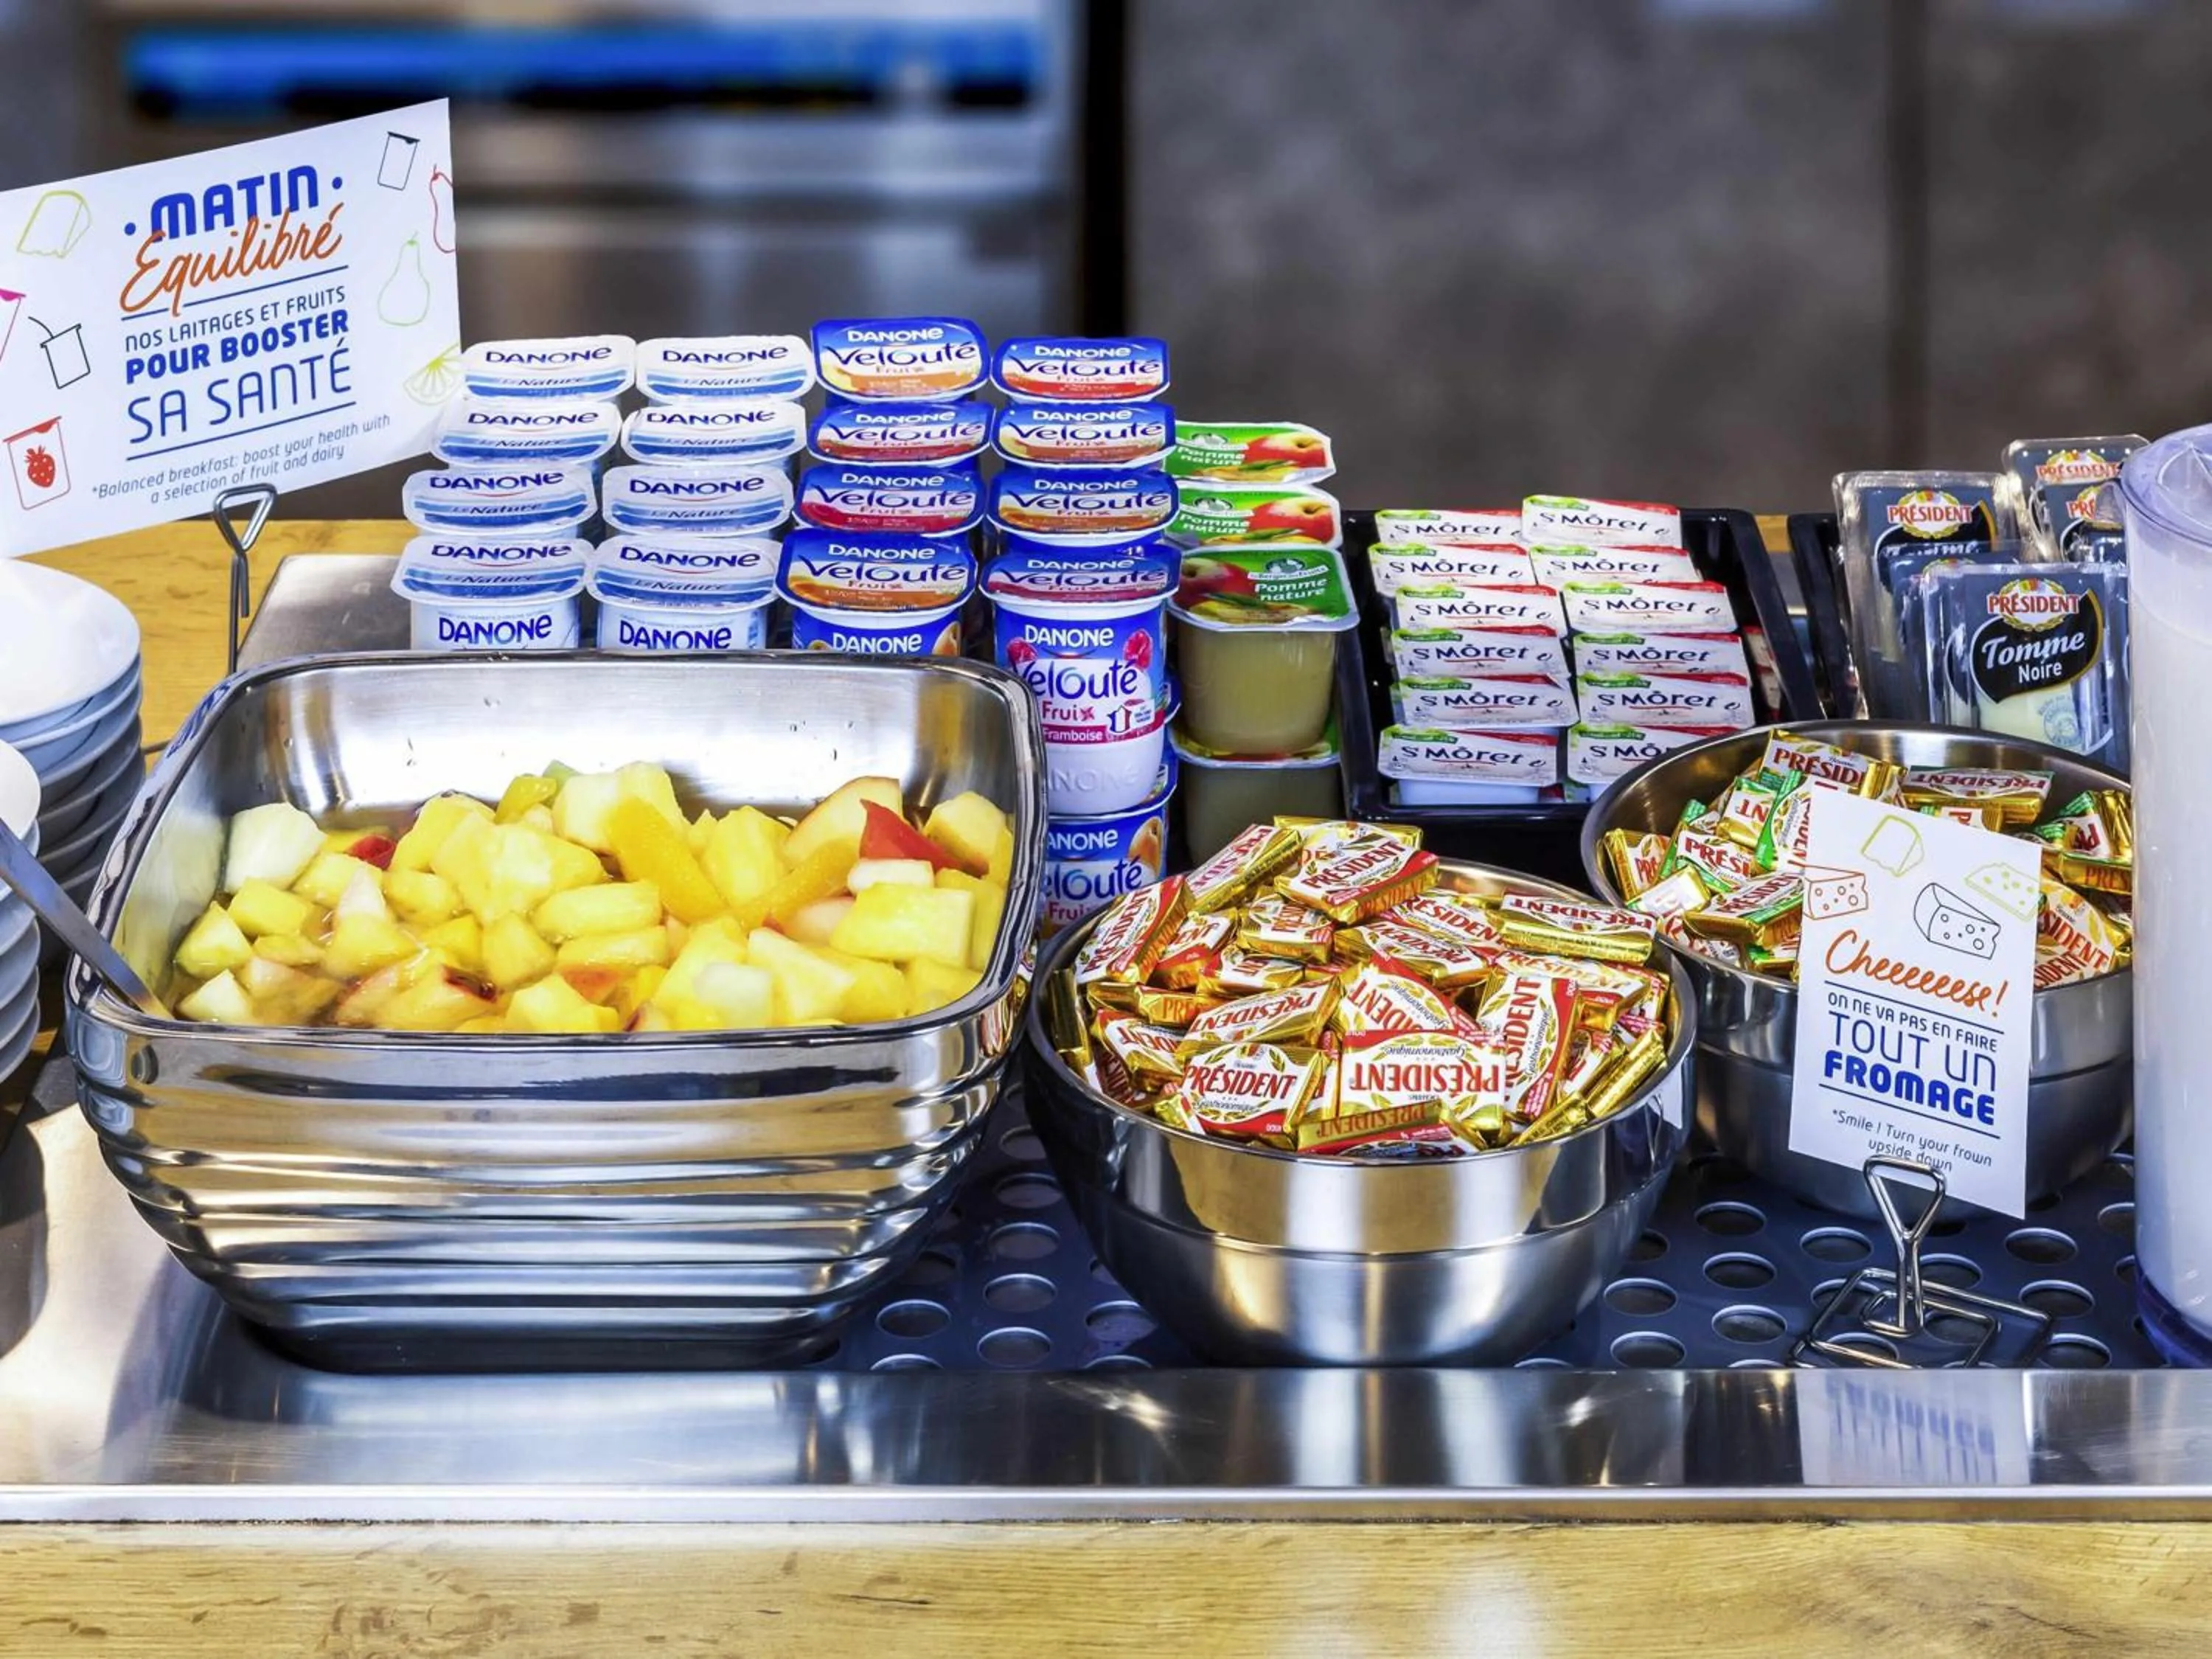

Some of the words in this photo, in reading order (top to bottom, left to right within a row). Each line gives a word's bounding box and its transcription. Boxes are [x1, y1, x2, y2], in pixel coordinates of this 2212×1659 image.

[150, 165, 319, 243] MATIN
[119, 202, 344, 317] Equilibré
[125, 330, 163, 352] NOS
[170, 308, 254, 342] LAITAGES
[260, 302, 280, 321] ET
[287, 286, 346, 315] FRUITS
[848, 327, 944, 343] DANONE
[126, 344, 210, 384] POUR
[221, 310, 349, 363] BOOSTER
[485, 347, 612, 364] DANONE
[663, 347, 789, 364] DANONE
[1034, 345, 1132, 358] DANONE
[128, 389, 187, 444] SA
[207, 337, 351, 425] SANTÉ
[467, 412, 599, 425] DANONE
[647, 411, 776, 425] DANONE
[855, 411, 956, 424] DANONE
[1032, 410, 1133, 422] DANONE
[168, 455, 239, 484] breakfast:
[243, 443, 280, 464] boost
[285, 436, 314, 457] your
[318, 422, 359, 446] health
[363, 414, 390, 433] with
[150, 492, 159, 504] a
[164, 476, 226, 499] selection
[232, 469, 246, 484] of
[250, 462, 279, 480] fruit
[283, 452, 308, 471] and
[311, 444, 344, 465] dairy
[430, 473, 564, 490] DANONE
[841, 473, 945, 487] DANONE
[1034, 479, 1138, 490] DANONE
[630, 477, 765, 495] DANONE
[1180, 514, 1251, 526] Pomme
[1889, 504, 1972, 524] PRÉSIDENT
[431, 545, 571, 560] DANONE
[620, 546, 760, 568] DANONE
[829, 544, 936, 559] DANONE
[1027, 560, 1134, 569] DANONE
[1255, 579, 1327, 593] Pomme
[1260, 588, 1325, 602] nature
[1989, 593, 2080, 615] PRÉSIDENT
[438, 614, 552, 644] DANONE
[619, 619, 731, 650] DANONE
[1025, 625, 1114, 647] DANONE
[832, 633, 922, 654] DANONE
[1982, 632, 2085, 669] Tomme
[1009, 658, 1138, 700] Velouté
[2018, 661, 2062, 684] Noire
[1044, 729, 1103, 741] Framboise
[1047, 829, 1119, 850] ANONE
[1048, 901, 1085, 921] Frui
[1828, 992, 1848, 1009] ON
[1853, 999, 1871, 1015] NE
[1876, 1005, 1894, 1022] VA
[1899, 1012, 1927, 1031] PAS
[1933, 1022, 1950, 1038] EN
[1956, 1029, 1997, 1052] FAIRE
[1829, 1010, 1930, 1069] TOUT
[1945, 1044, 1995, 1091] UN
[1181, 1064, 1298, 1100] PRÉSIDENT
[1349, 1060, 1500, 1098] PRÉSIDENT
[1824, 1049, 1994, 1125] FROMAGE
[1868, 1139, 1912, 1158] upside
[1916, 1151, 1952, 1172] down
[1886, 1124, 1915, 1143] Turn
[1919, 1135, 1950, 1153] your
[1954, 1144, 1992, 1166] frown
